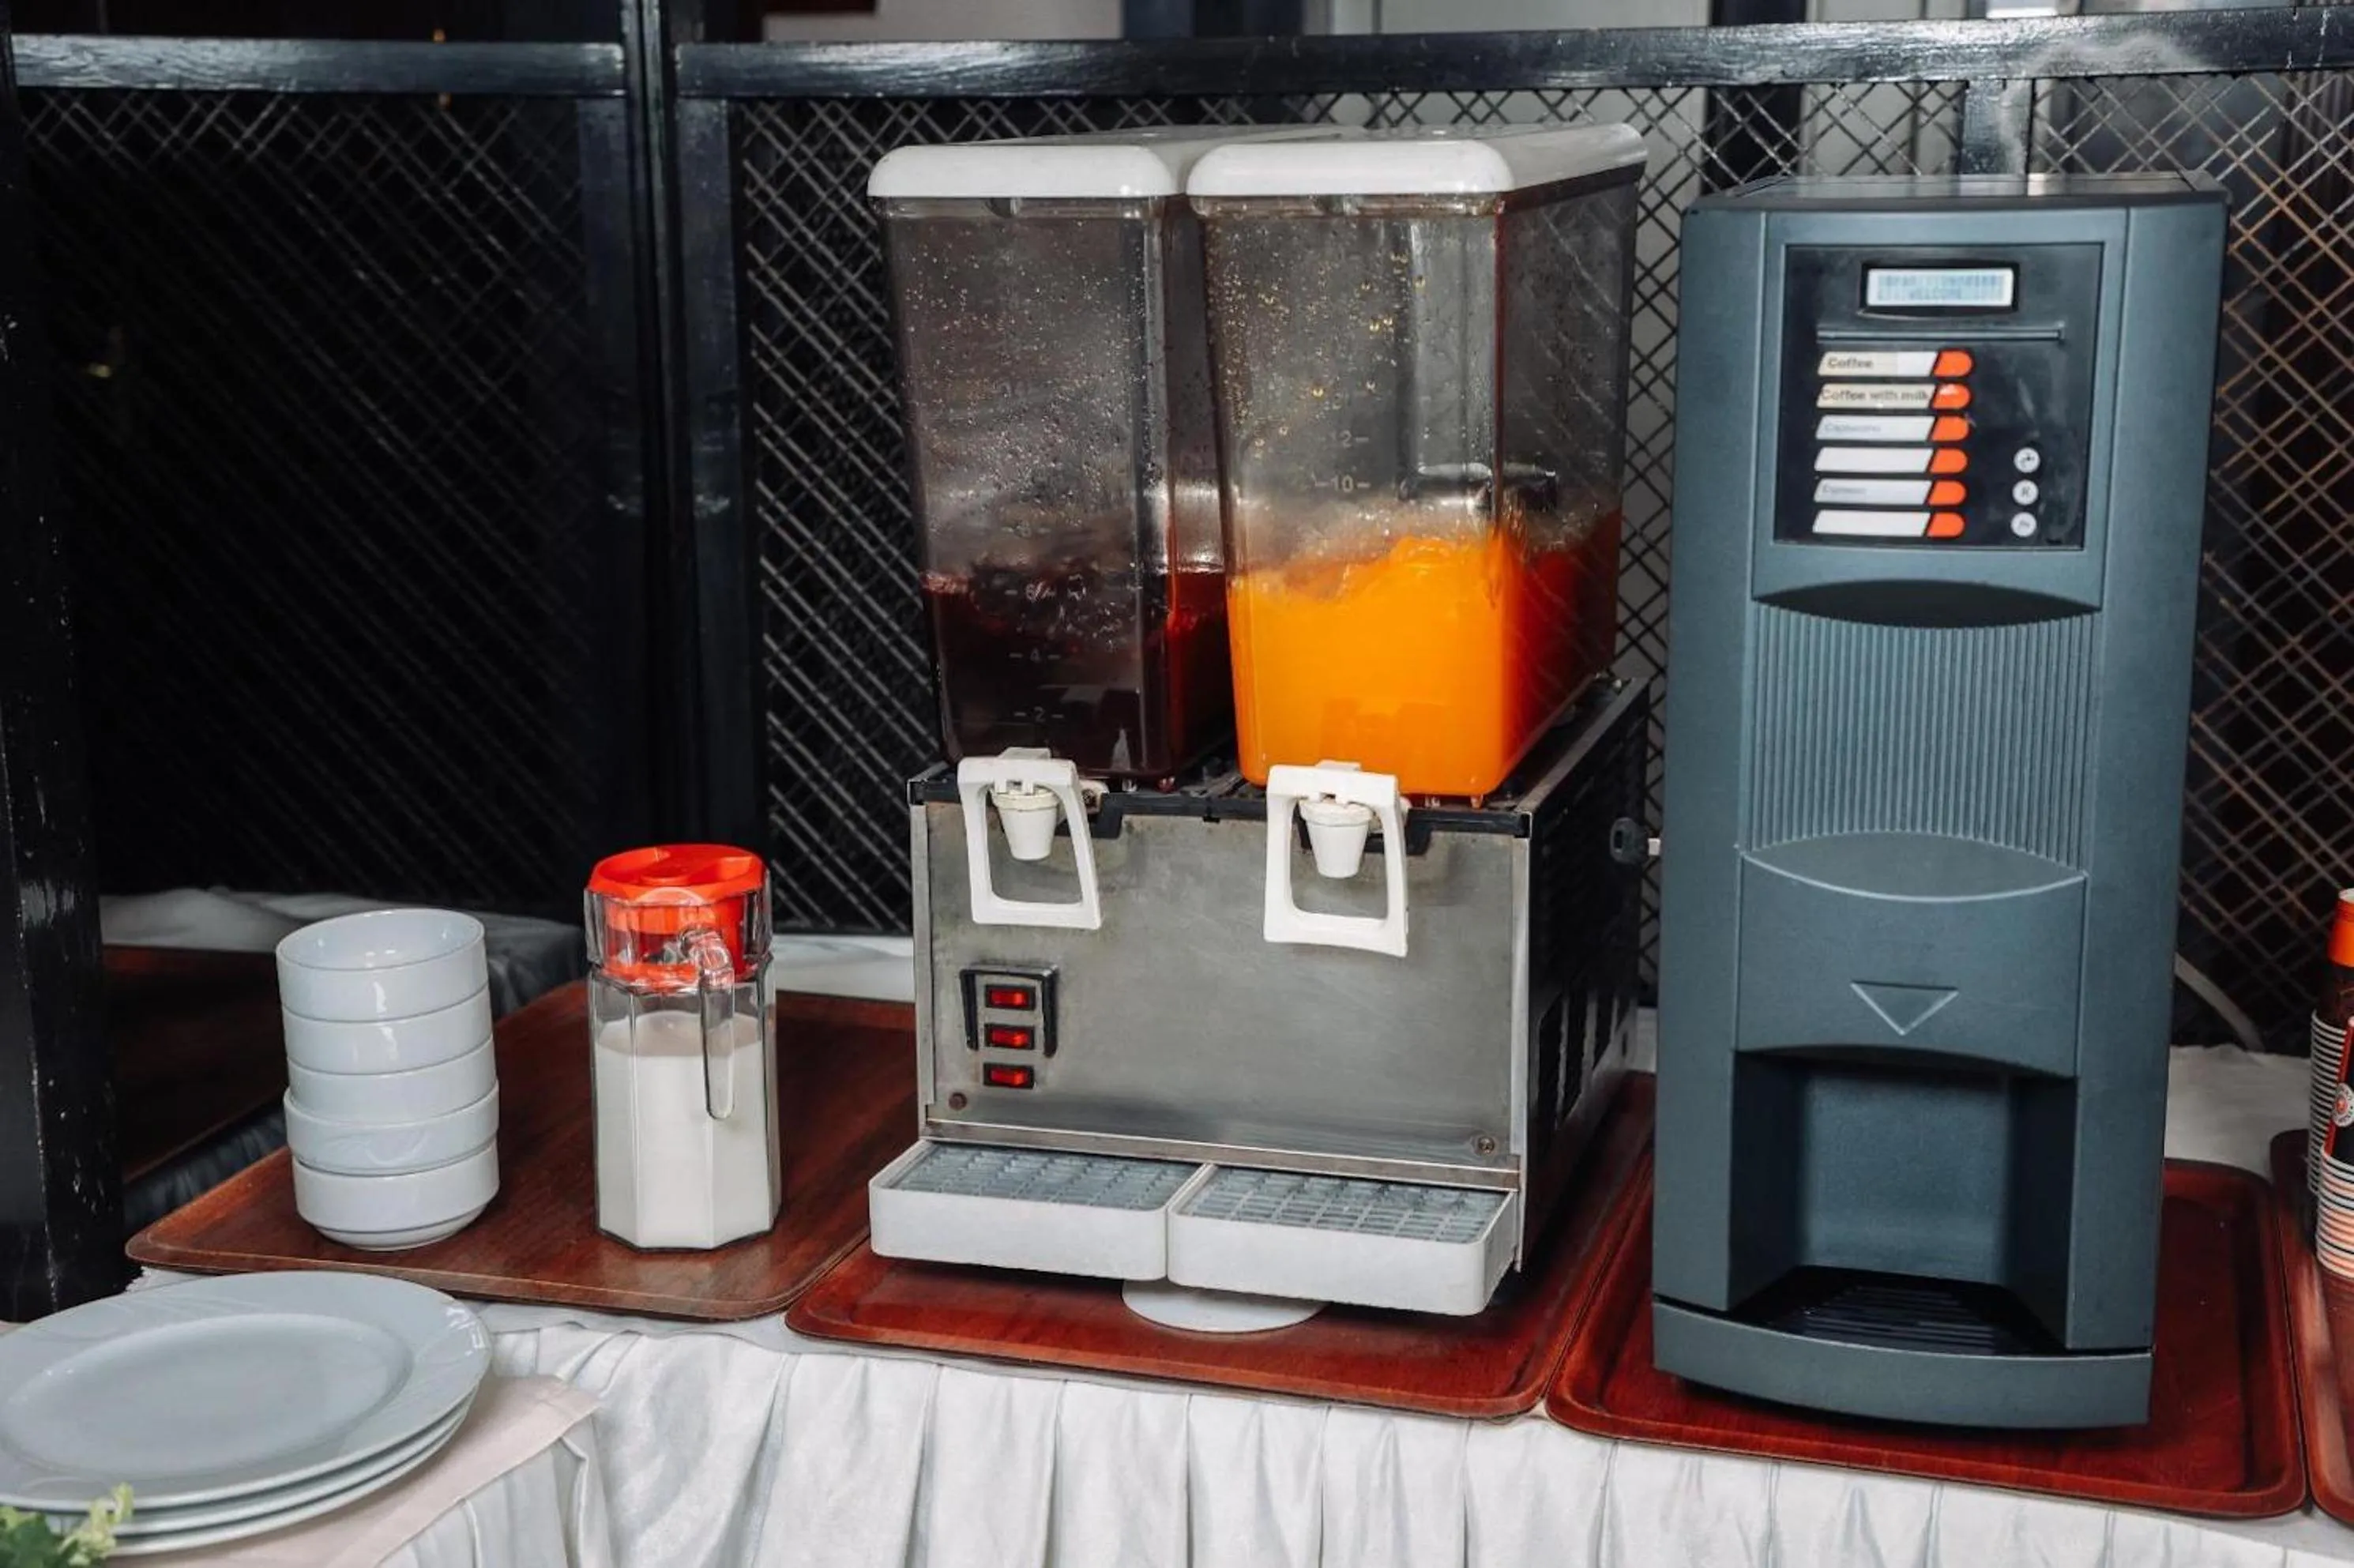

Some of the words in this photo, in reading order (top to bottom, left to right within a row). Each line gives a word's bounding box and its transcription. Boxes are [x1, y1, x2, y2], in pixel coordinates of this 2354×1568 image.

[1826, 357, 1873, 369] Coffee
[1822, 389, 1865, 400] Coffee
[1870, 389, 1897, 400] with
[1901, 390, 1927, 400] milk
[1330, 474, 1354, 493] 10
[1030, 647, 1041, 664] 4
[1033, 706, 1046, 723] 2
